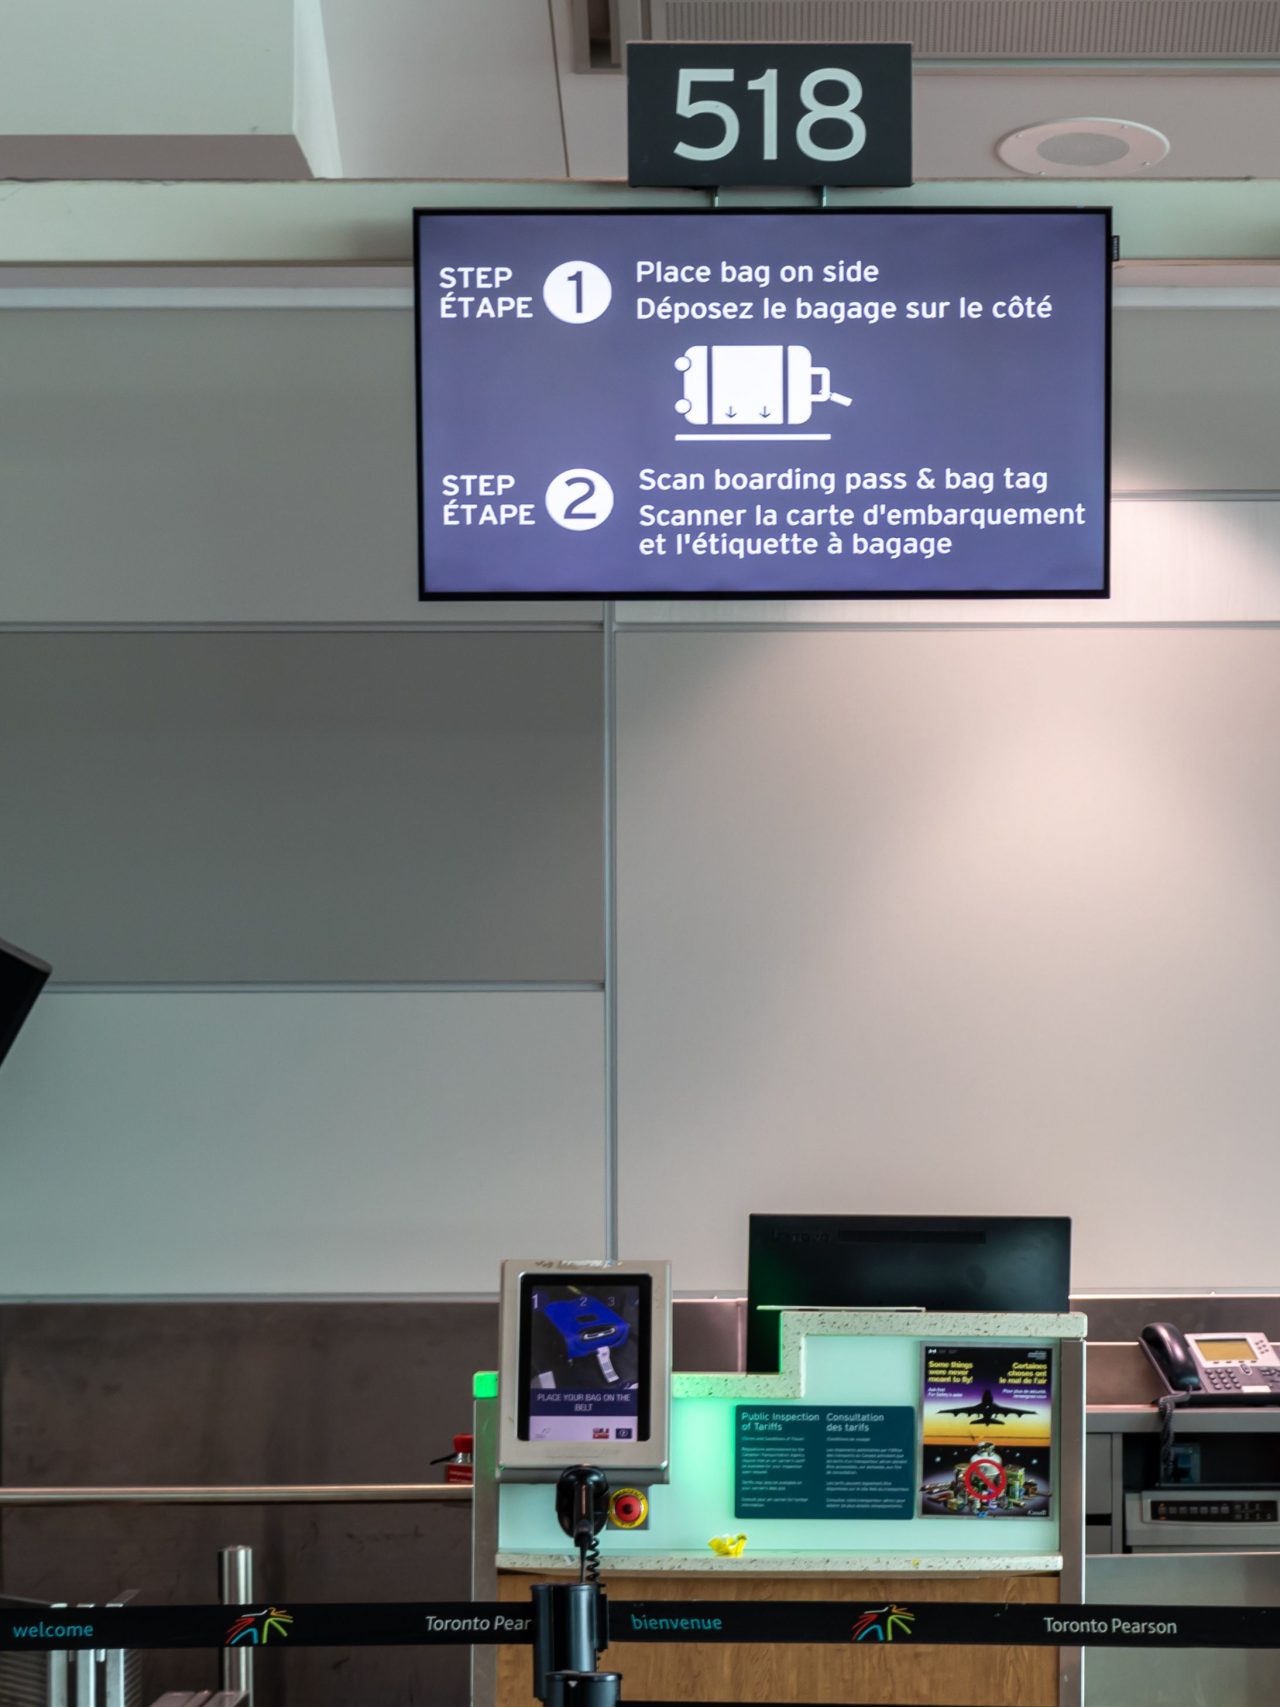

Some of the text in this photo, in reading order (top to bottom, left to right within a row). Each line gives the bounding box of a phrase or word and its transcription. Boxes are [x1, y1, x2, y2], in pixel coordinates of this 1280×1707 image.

[674, 68, 866, 161] 518
[440, 267, 512, 288] STEP
[637, 260, 879, 287] Place bag on side
[566, 271, 585, 314] 1
[441, 292, 533, 318] ÉTAPE
[637, 295, 1052, 324] Déposez le bagage sur le côté
[443, 475, 515, 496] STEP
[640, 468, 1047, 494] Scan boarding pass & bag tag
[563, 478, 597, 519] 2
[444, 501, 535, 525] ÉTAPE
[640, 504, 1085, 529] Scanner la carte d'embarquement
[639, 532, 952, 559] et l'étiquette à bagage
[951, 1361, 973, 1370] things
[742, 1412, 819, 1421] Public Inspection
[742, 1422, 782, 1430] of Tariffs
[826, 1423, 869, 1431] des tarifs
[827, 1413, 884, 1421] Consultation
[13, 1622, 93, 1637] welcome
[426, 1616, 530, 1631] Toronto Pear
[632, 1614, 722, 1629] bienvenue
[1044, 1617, 1176, 1634] Toronto Pearson
